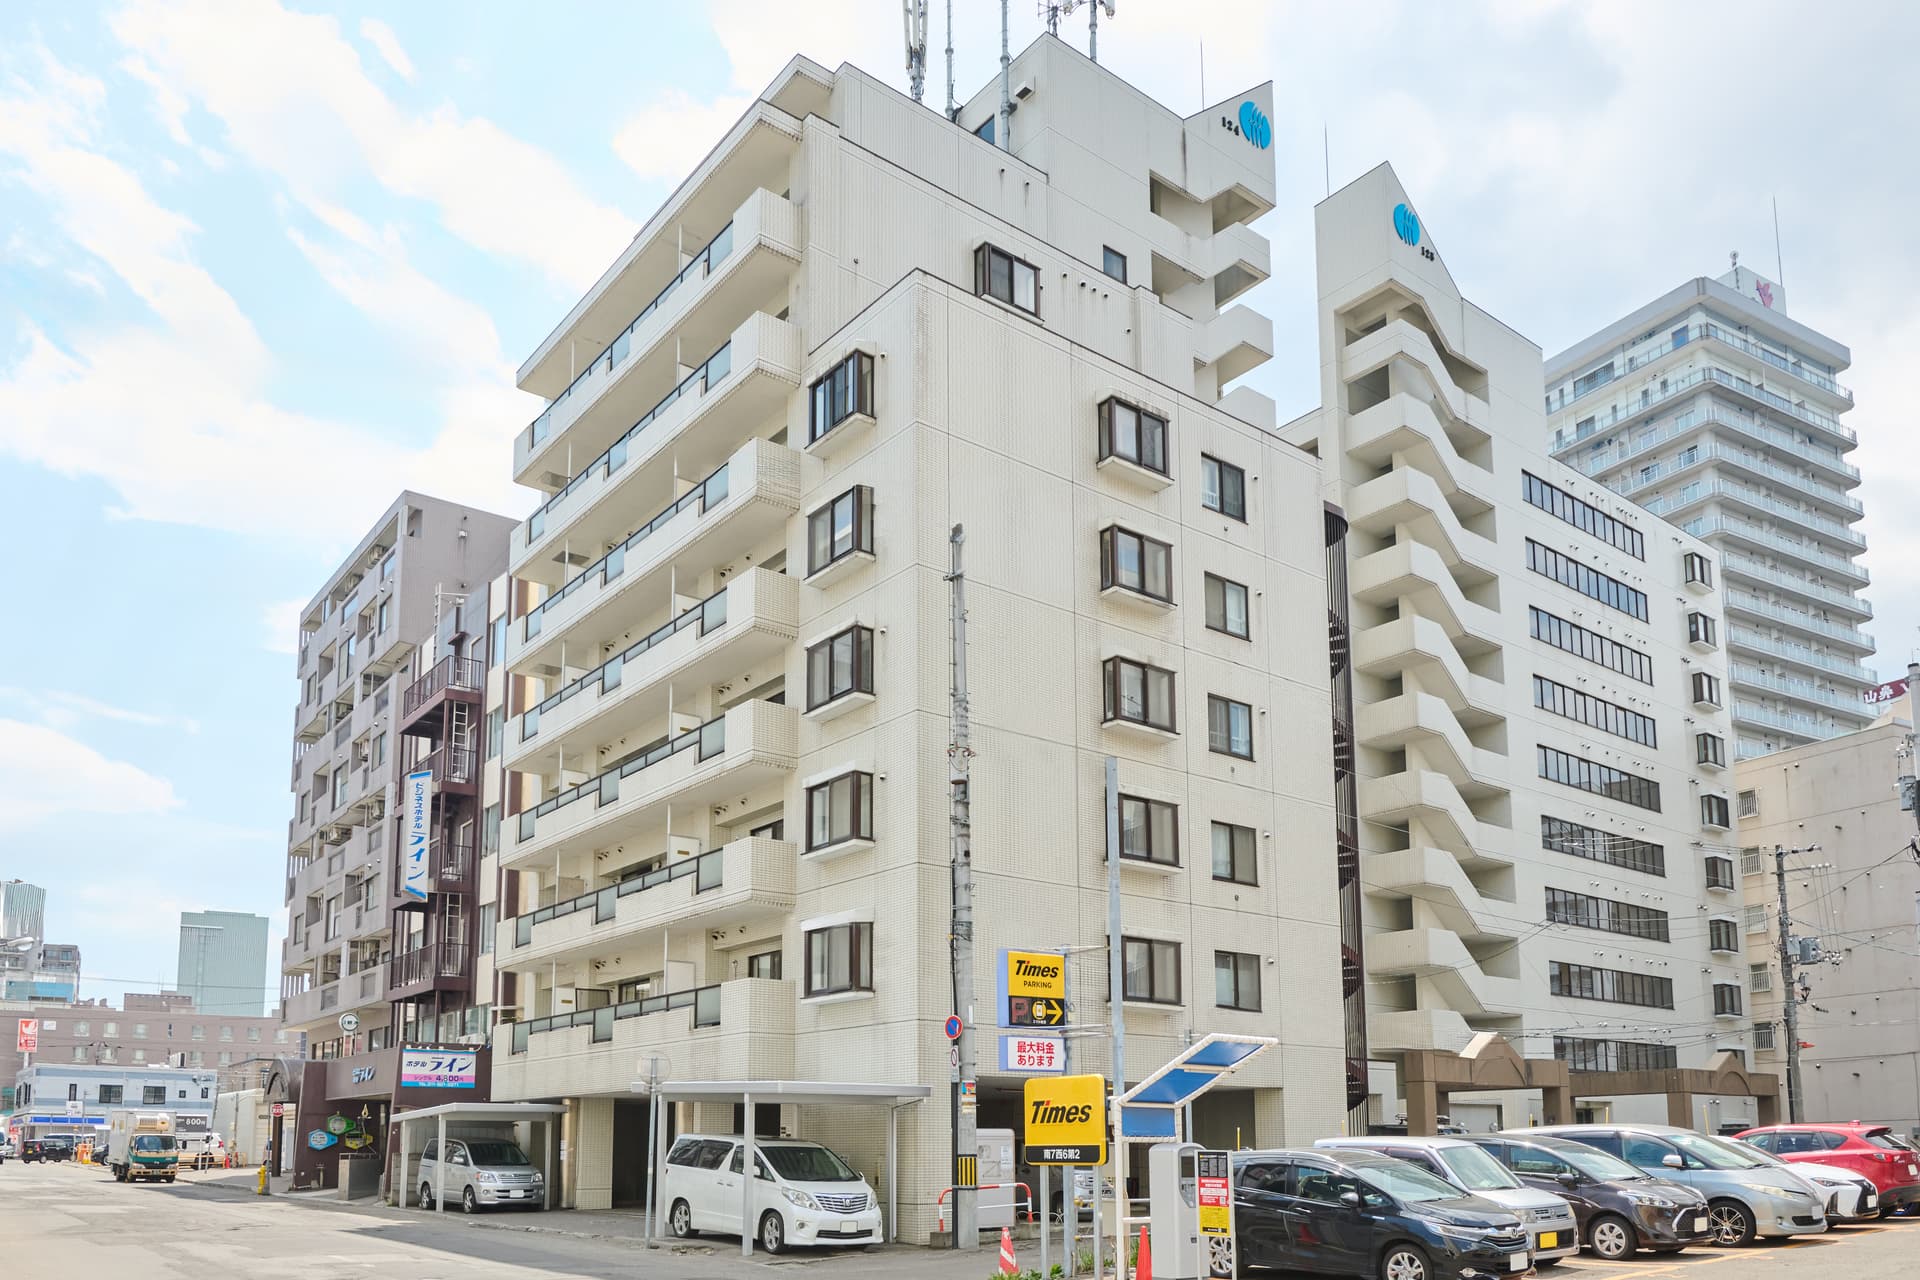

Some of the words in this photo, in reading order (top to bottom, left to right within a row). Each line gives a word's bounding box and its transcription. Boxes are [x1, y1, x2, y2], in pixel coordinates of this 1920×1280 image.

[1222, 116, 1240, 136] 124
[408, 831, 427, 880] ライン
[1015, 959, 1059, 978] Times
[1023, 980, 1053, 989] PARKING
[1017, 1041, 1055, 1055] 最大料金
[429, 1057, 473, 1073] ライン
[1017, 1055, 1055, 1067] あります
[1031, 1100, 1093, 1124] Times
[1043, 1148, 1081, 1160] 南7西6第2
